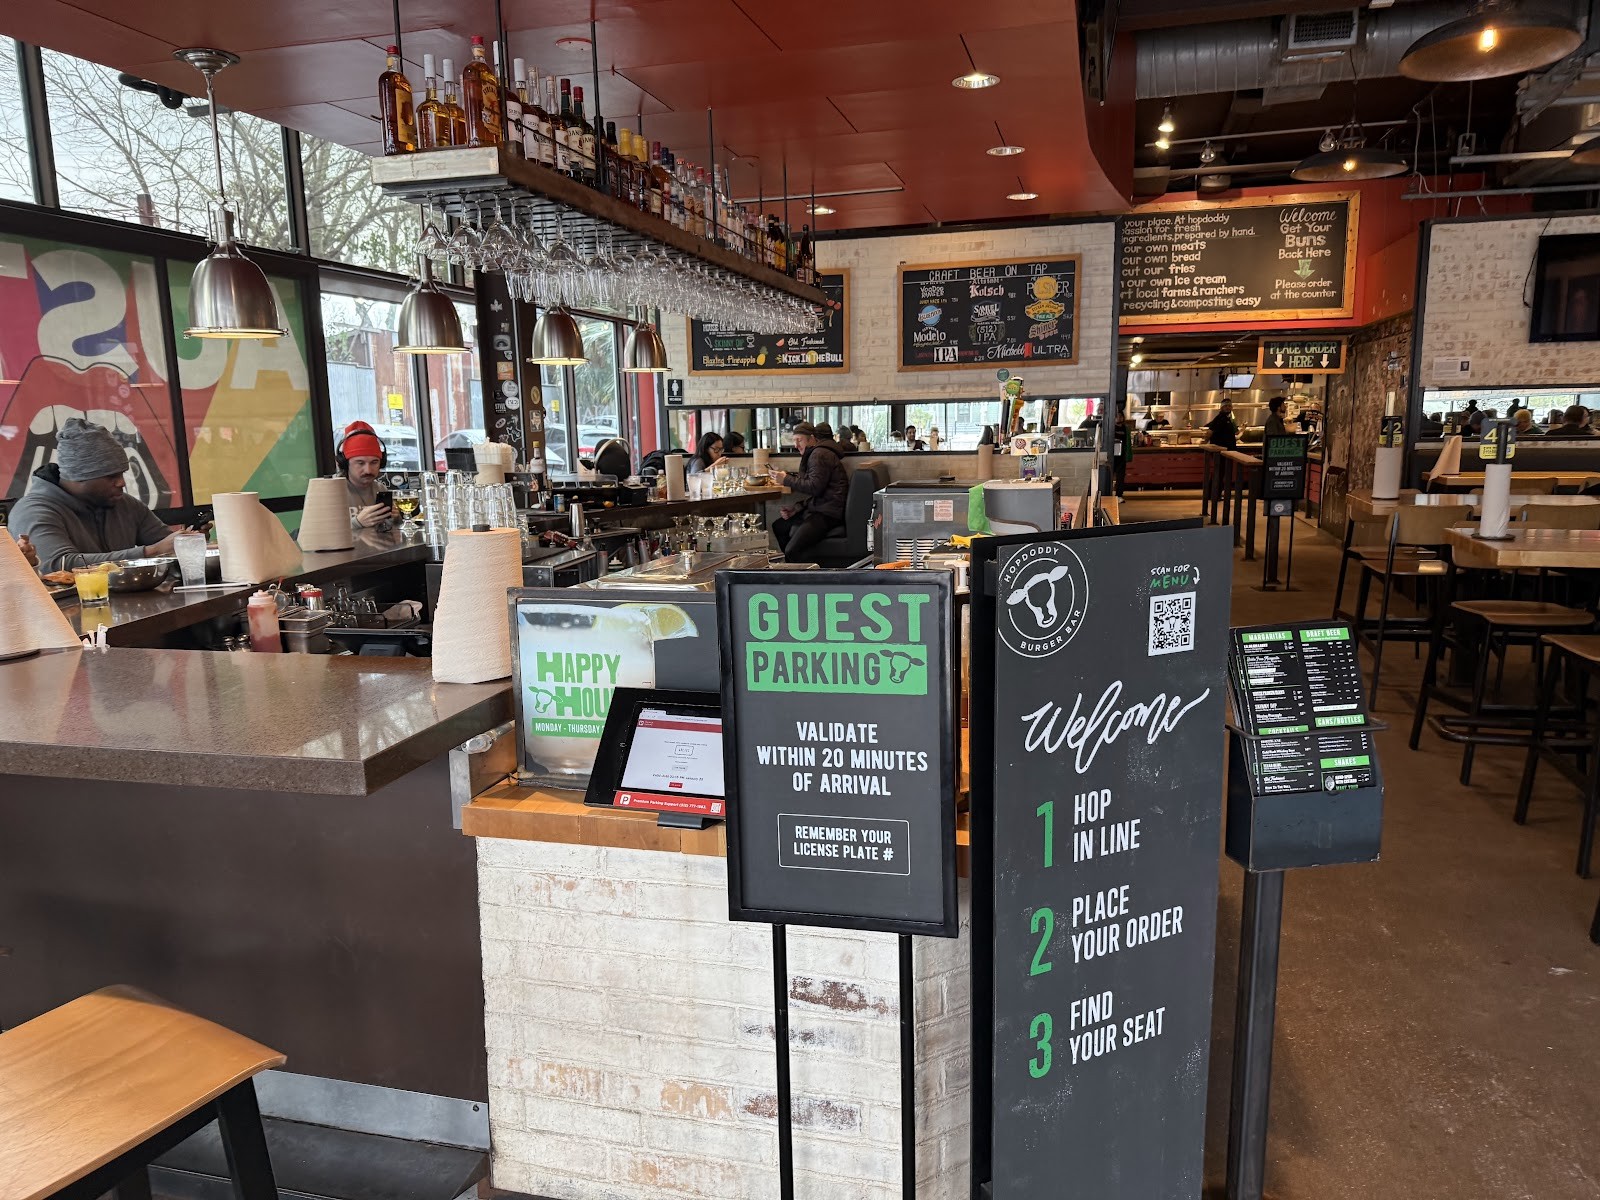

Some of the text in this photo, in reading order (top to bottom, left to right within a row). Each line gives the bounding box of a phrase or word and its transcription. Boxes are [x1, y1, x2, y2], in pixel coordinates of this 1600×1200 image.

[1125, 214, 1229, 229] your place. At hopdoddy
[1280, 208, 1336, 222] Welcome
[1174, 224, 1200, 232] fresh
[1219, 228, 1229, 238] by
[1232, 227, 1255, 236] hand.
[1280, 222, 1332, 234] Get Your
[1171, 240, 1206, 251] meats
[1285, 235, 1326, 247] Buns
[1122, 257, 1141, 265] our
[1172, 251, 1200, 262] bread
[1279, 248, 1331, 259] Back Here
[929, 264, 1048, 281] CRAFT BEER ON TAP
[1122, 264, 1196, 276] cut our fries
[1127, 280, 1146, 288] our
[1175, 276, 1190, 285] ice
[1193, 276, 1226, 285] cream
[1276, 278, 1332, 289] Please order
[1136, 288, 1159, 297] local
[1270, 290, 1337, 299] at the counter
[1236, 296, 1261, 308] easy
[914, 330, 946, 342] Modelo
[977, 325, 997, 334] (512)
[736, 339, 744, 347] DIP
[1033, 345, 1069, 354] ULTRA
[1270, 341, 1337, 354] PLACE ORDER
[727, 355, 756, 366] Pineapple
[934, 348, 958, 362] IPA
[1289, 356, 1314, 368] HERE
[1270, 438, 1305, 447] GUEST
[1004, 546, 1060, 583] HOPDODDY
[1150, 564, 1190, 575] SCAN FOR
[1150, 574, 1189, 589] MENU
[748, 592, 930, 643] GUEST
[1020, 609, 1081, 651] BURGER BAR
[536, 652, 621, 684] HAPPY
[752, 650, 881, 686] PARKING
[554, 686, 616, 717] HOU
[536, 722, 562, 732] MONDAY
[568, 724, 600, 734] THURSDAY
[797, 722, 878, 743] VALIDATE
[1021, 680, 1210, 774] Welcome
[757, 746, 928, 771] WITHIN 20 MINUTES
[1334, 758, 1356, 766] SHAKES
[792, 773, 891, 796] OF ARRIVAL
[795, 826, 892, 844] REMEMBER YOUR
[1036, 788, 1112, 868] 1 HOP
[1073, 818, 1141, 862] IN LINE
[793, 842, 894, 861] LICENSE PLATE #
[1030, 884, 1130, 976] 2 PLACE
[1071, 905, 1183, 964] YOUR ORDER
[1029, 990, 1113, 1078] 3 FIND
[1069, 1007, 1165, 1065] YOUR SEAT
